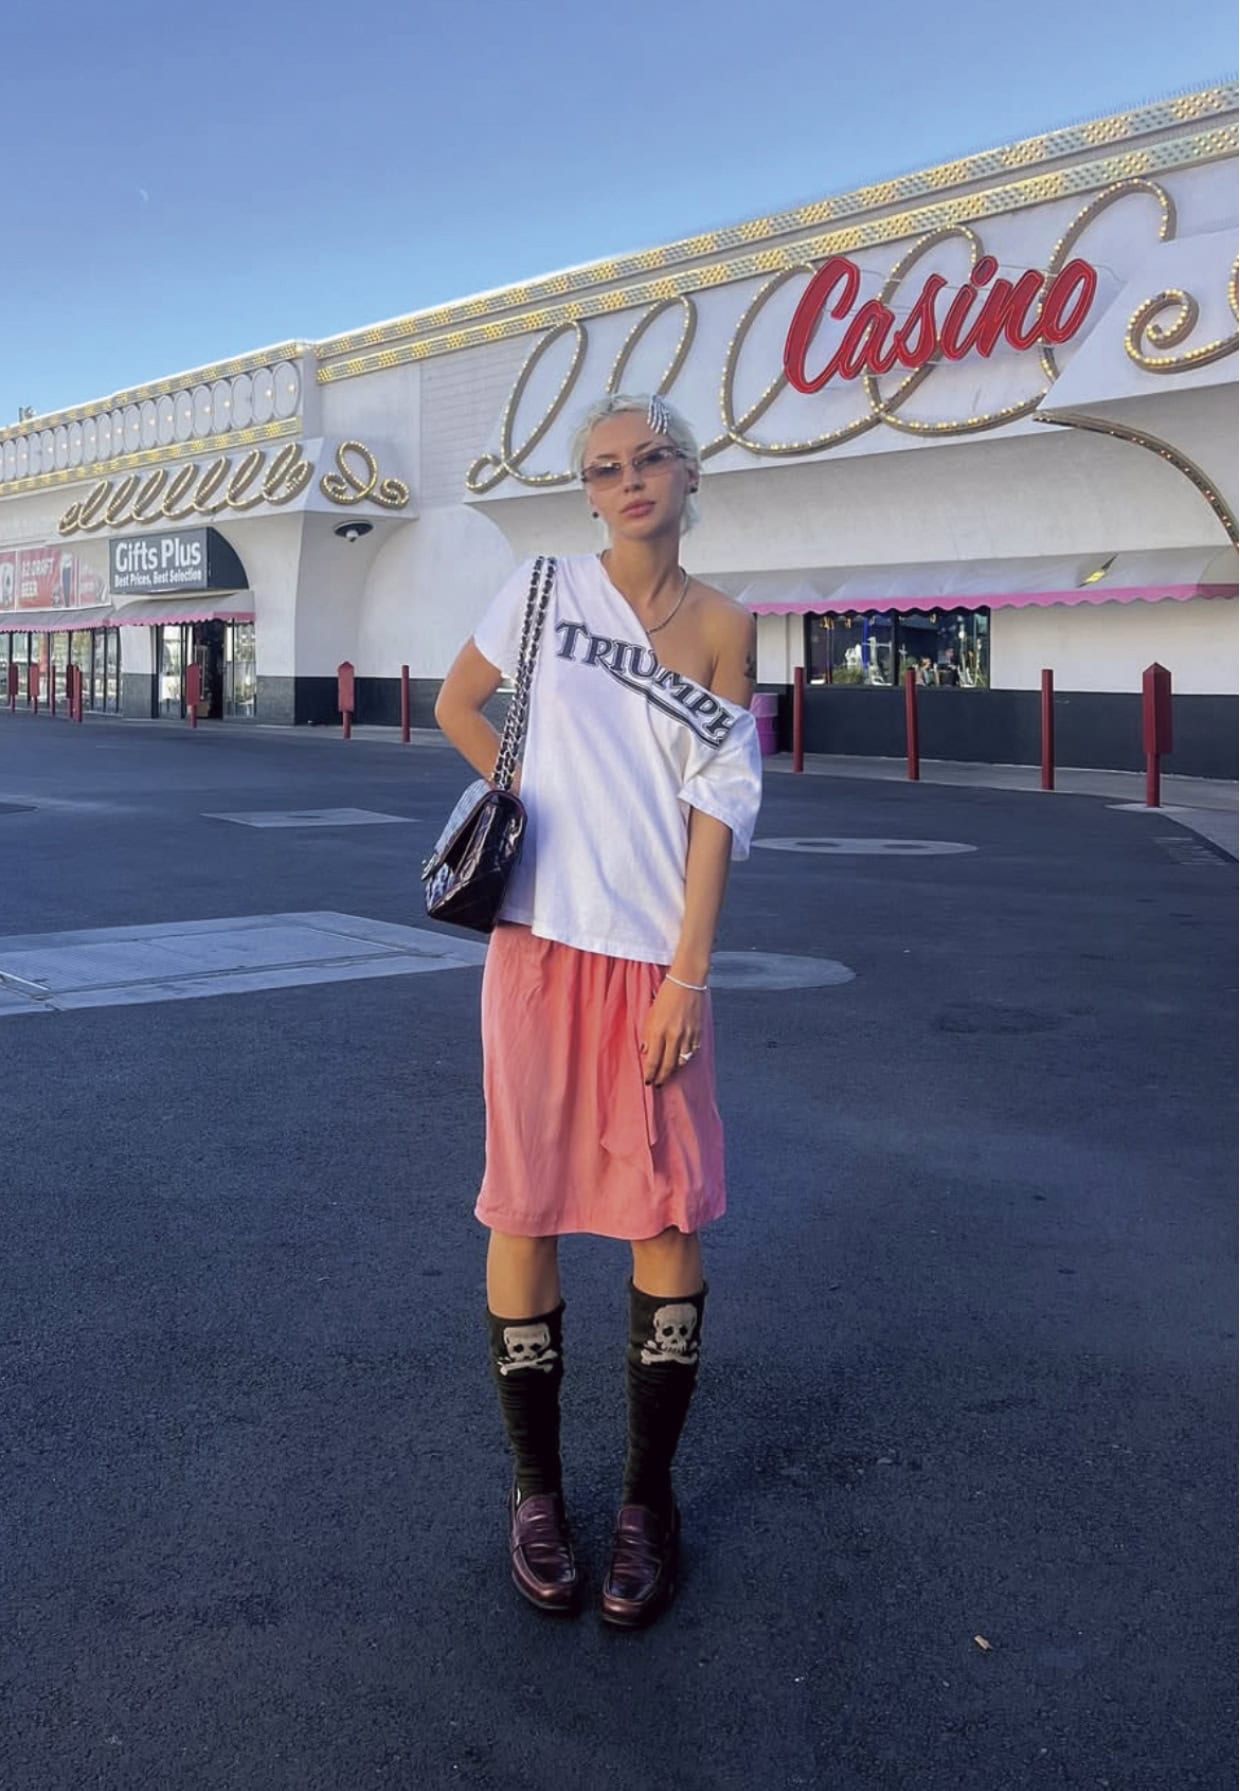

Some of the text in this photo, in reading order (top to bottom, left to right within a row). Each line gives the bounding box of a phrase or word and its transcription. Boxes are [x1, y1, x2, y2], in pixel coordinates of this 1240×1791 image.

[784, 255, 1097, 393] Casino
[115, 537, 201, 572] Gifts Plus
[114, 573, 129, 588] Best
[153, 570, 169, 585] Best
[169, 567, 202, 583] Selection
